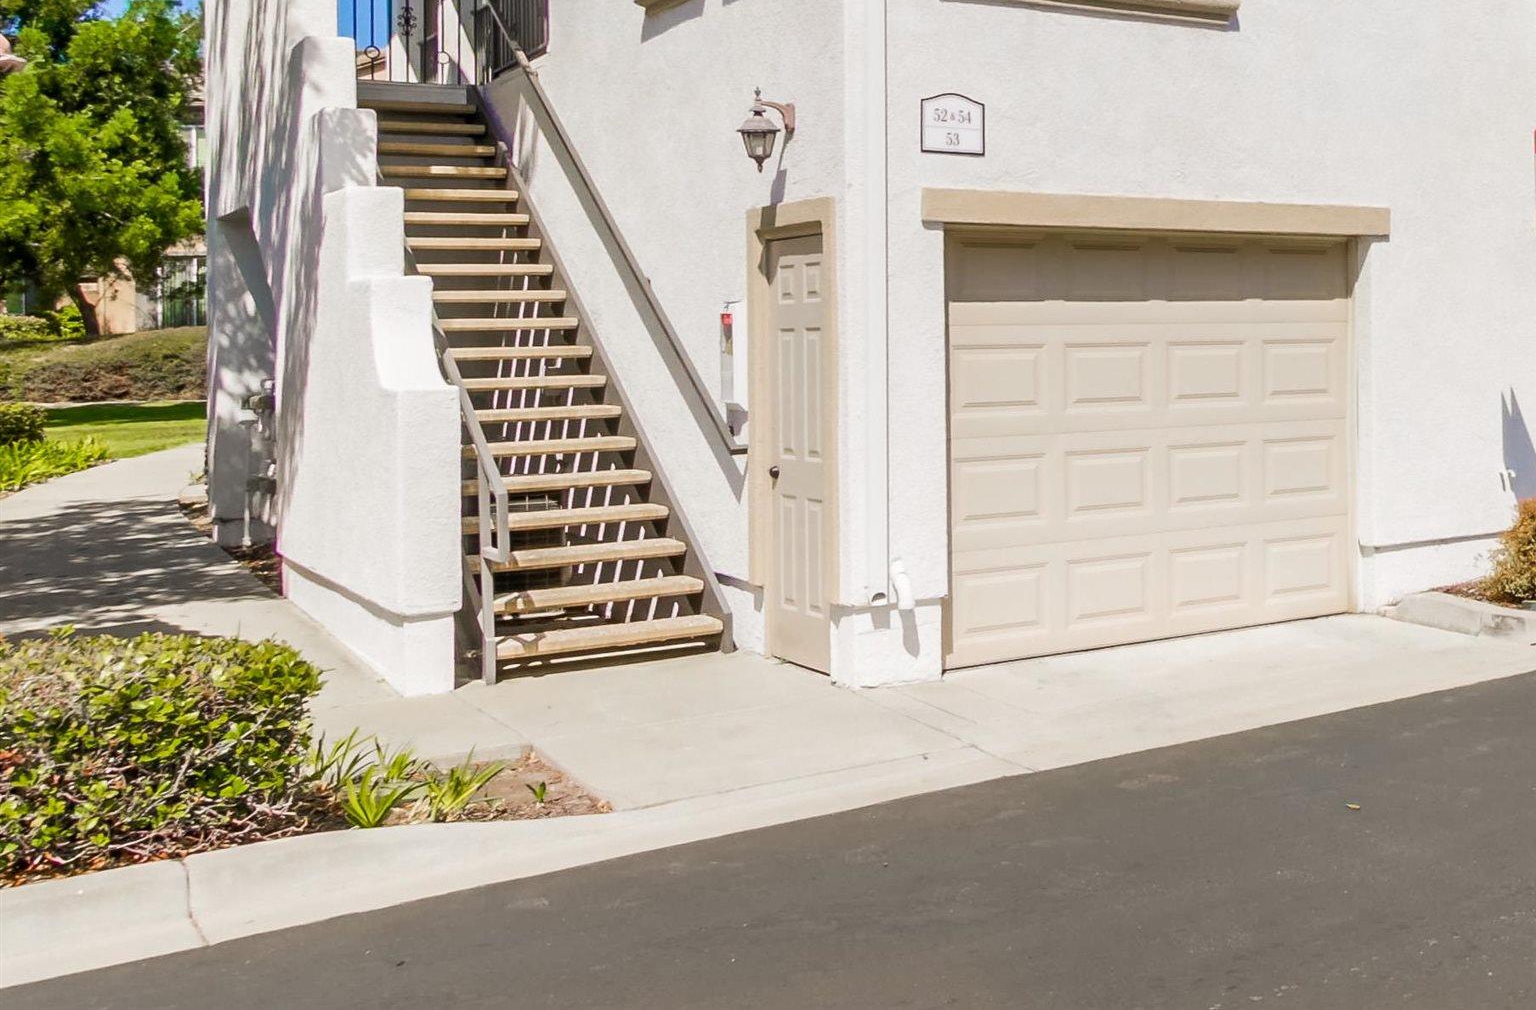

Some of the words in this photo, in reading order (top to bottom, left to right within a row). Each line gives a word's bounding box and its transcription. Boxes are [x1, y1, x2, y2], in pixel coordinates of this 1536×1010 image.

[933, 108, 948, 122] 52
[958, 110, 971, 124] 54
[945, 132, 960, 146] 53
